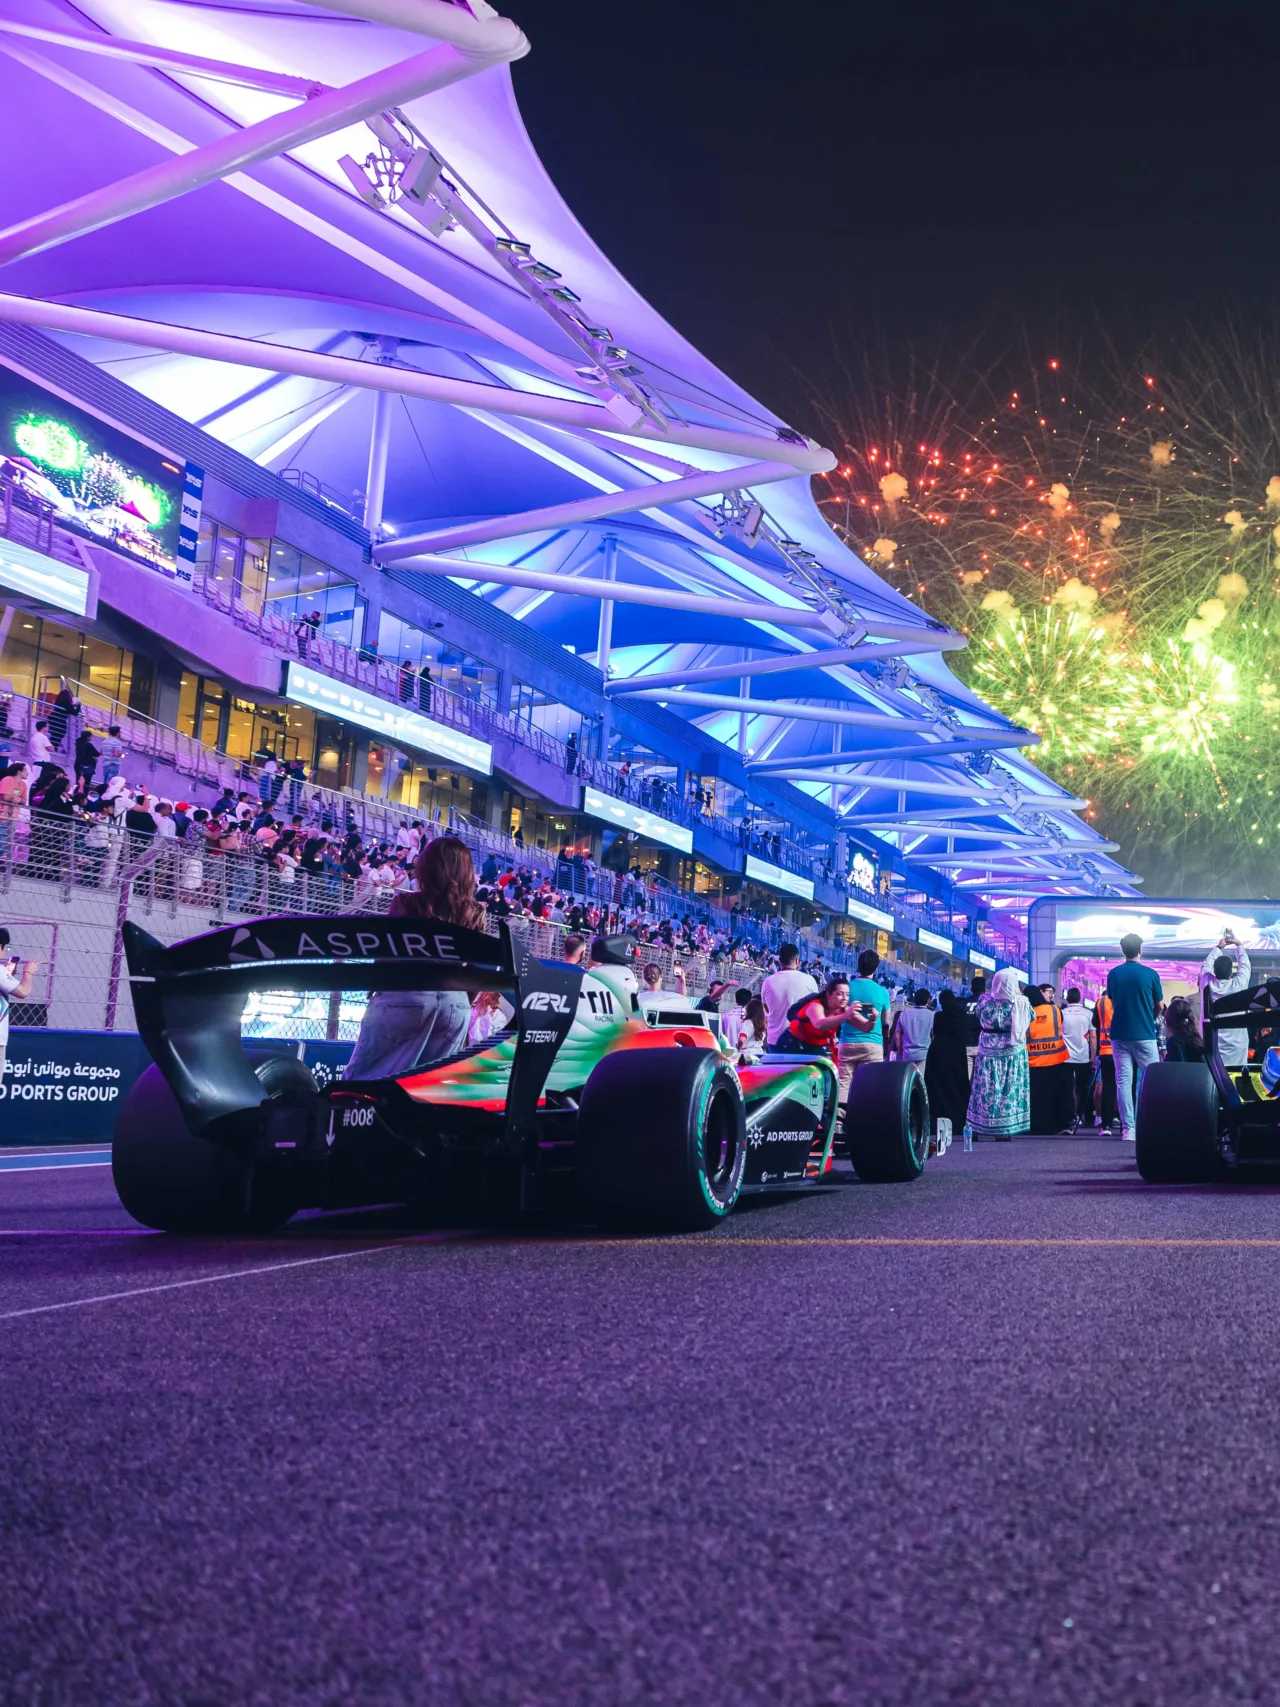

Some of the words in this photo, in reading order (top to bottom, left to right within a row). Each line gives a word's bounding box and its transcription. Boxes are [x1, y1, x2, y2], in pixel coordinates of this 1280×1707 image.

[185, 472, 202, 488] YAS
[182, 504, 198, 519] YAS
[179, 535, 195, 551] YAS
[176, 568, 191, 581] YAS
[297, 932, 461, 959] ASPIRE
[521, 991, 571, 1014] A2RL
[594, 1015, 614, 1023] RACING
[1029, 1042, 1057, 1051] MEDIA
[73, 1062, 121, 1080] مجموعة
[10, 1084, 64, 1100] PORTS
[66, 1086, 119, 1101] GROUP
[342, 1108, 374, 1127] #008
[766, 1130, 778, 1142] AD
[779, 1131, 798, 1142] PORTS
[798, 1131, 814, 1141] GROUP
